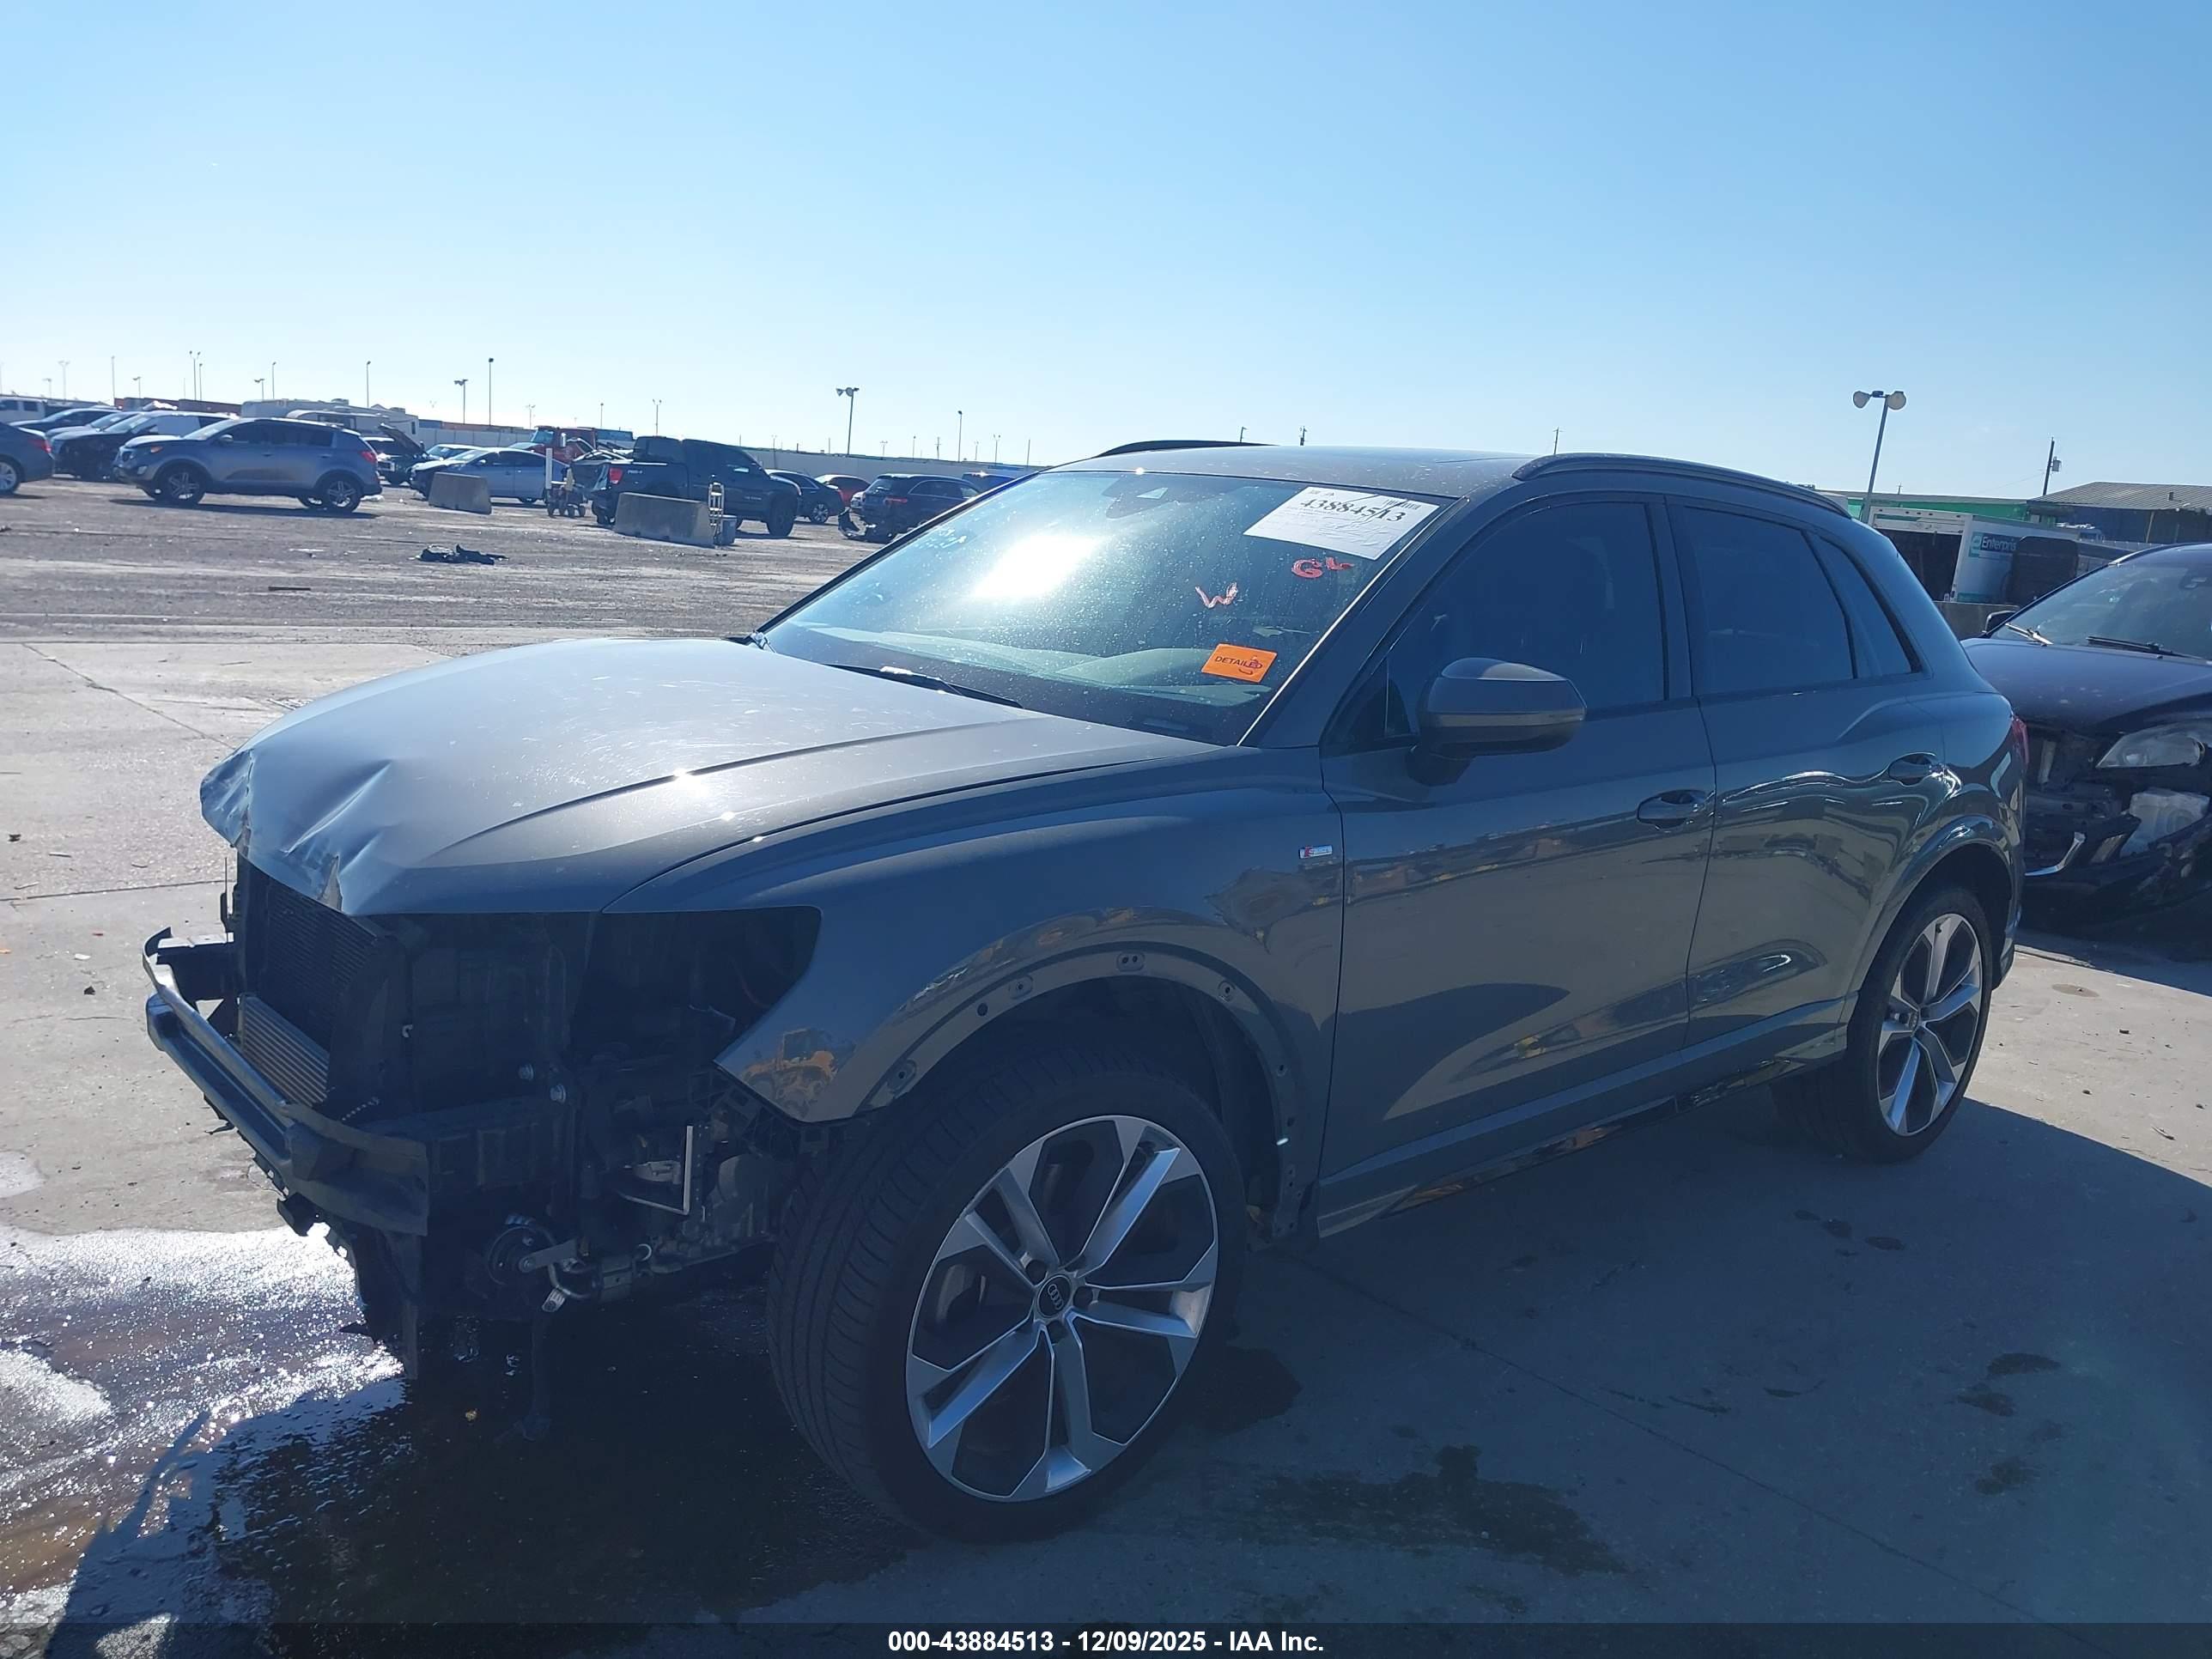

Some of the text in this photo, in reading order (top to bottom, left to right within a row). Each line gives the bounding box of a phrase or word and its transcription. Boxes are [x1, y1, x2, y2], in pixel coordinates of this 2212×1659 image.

[1300, 496, 1407, 523] 43884513
[1982, 536, 2019, 551] Enterpris
[1215, 655, 1262, 669] DETAILED
